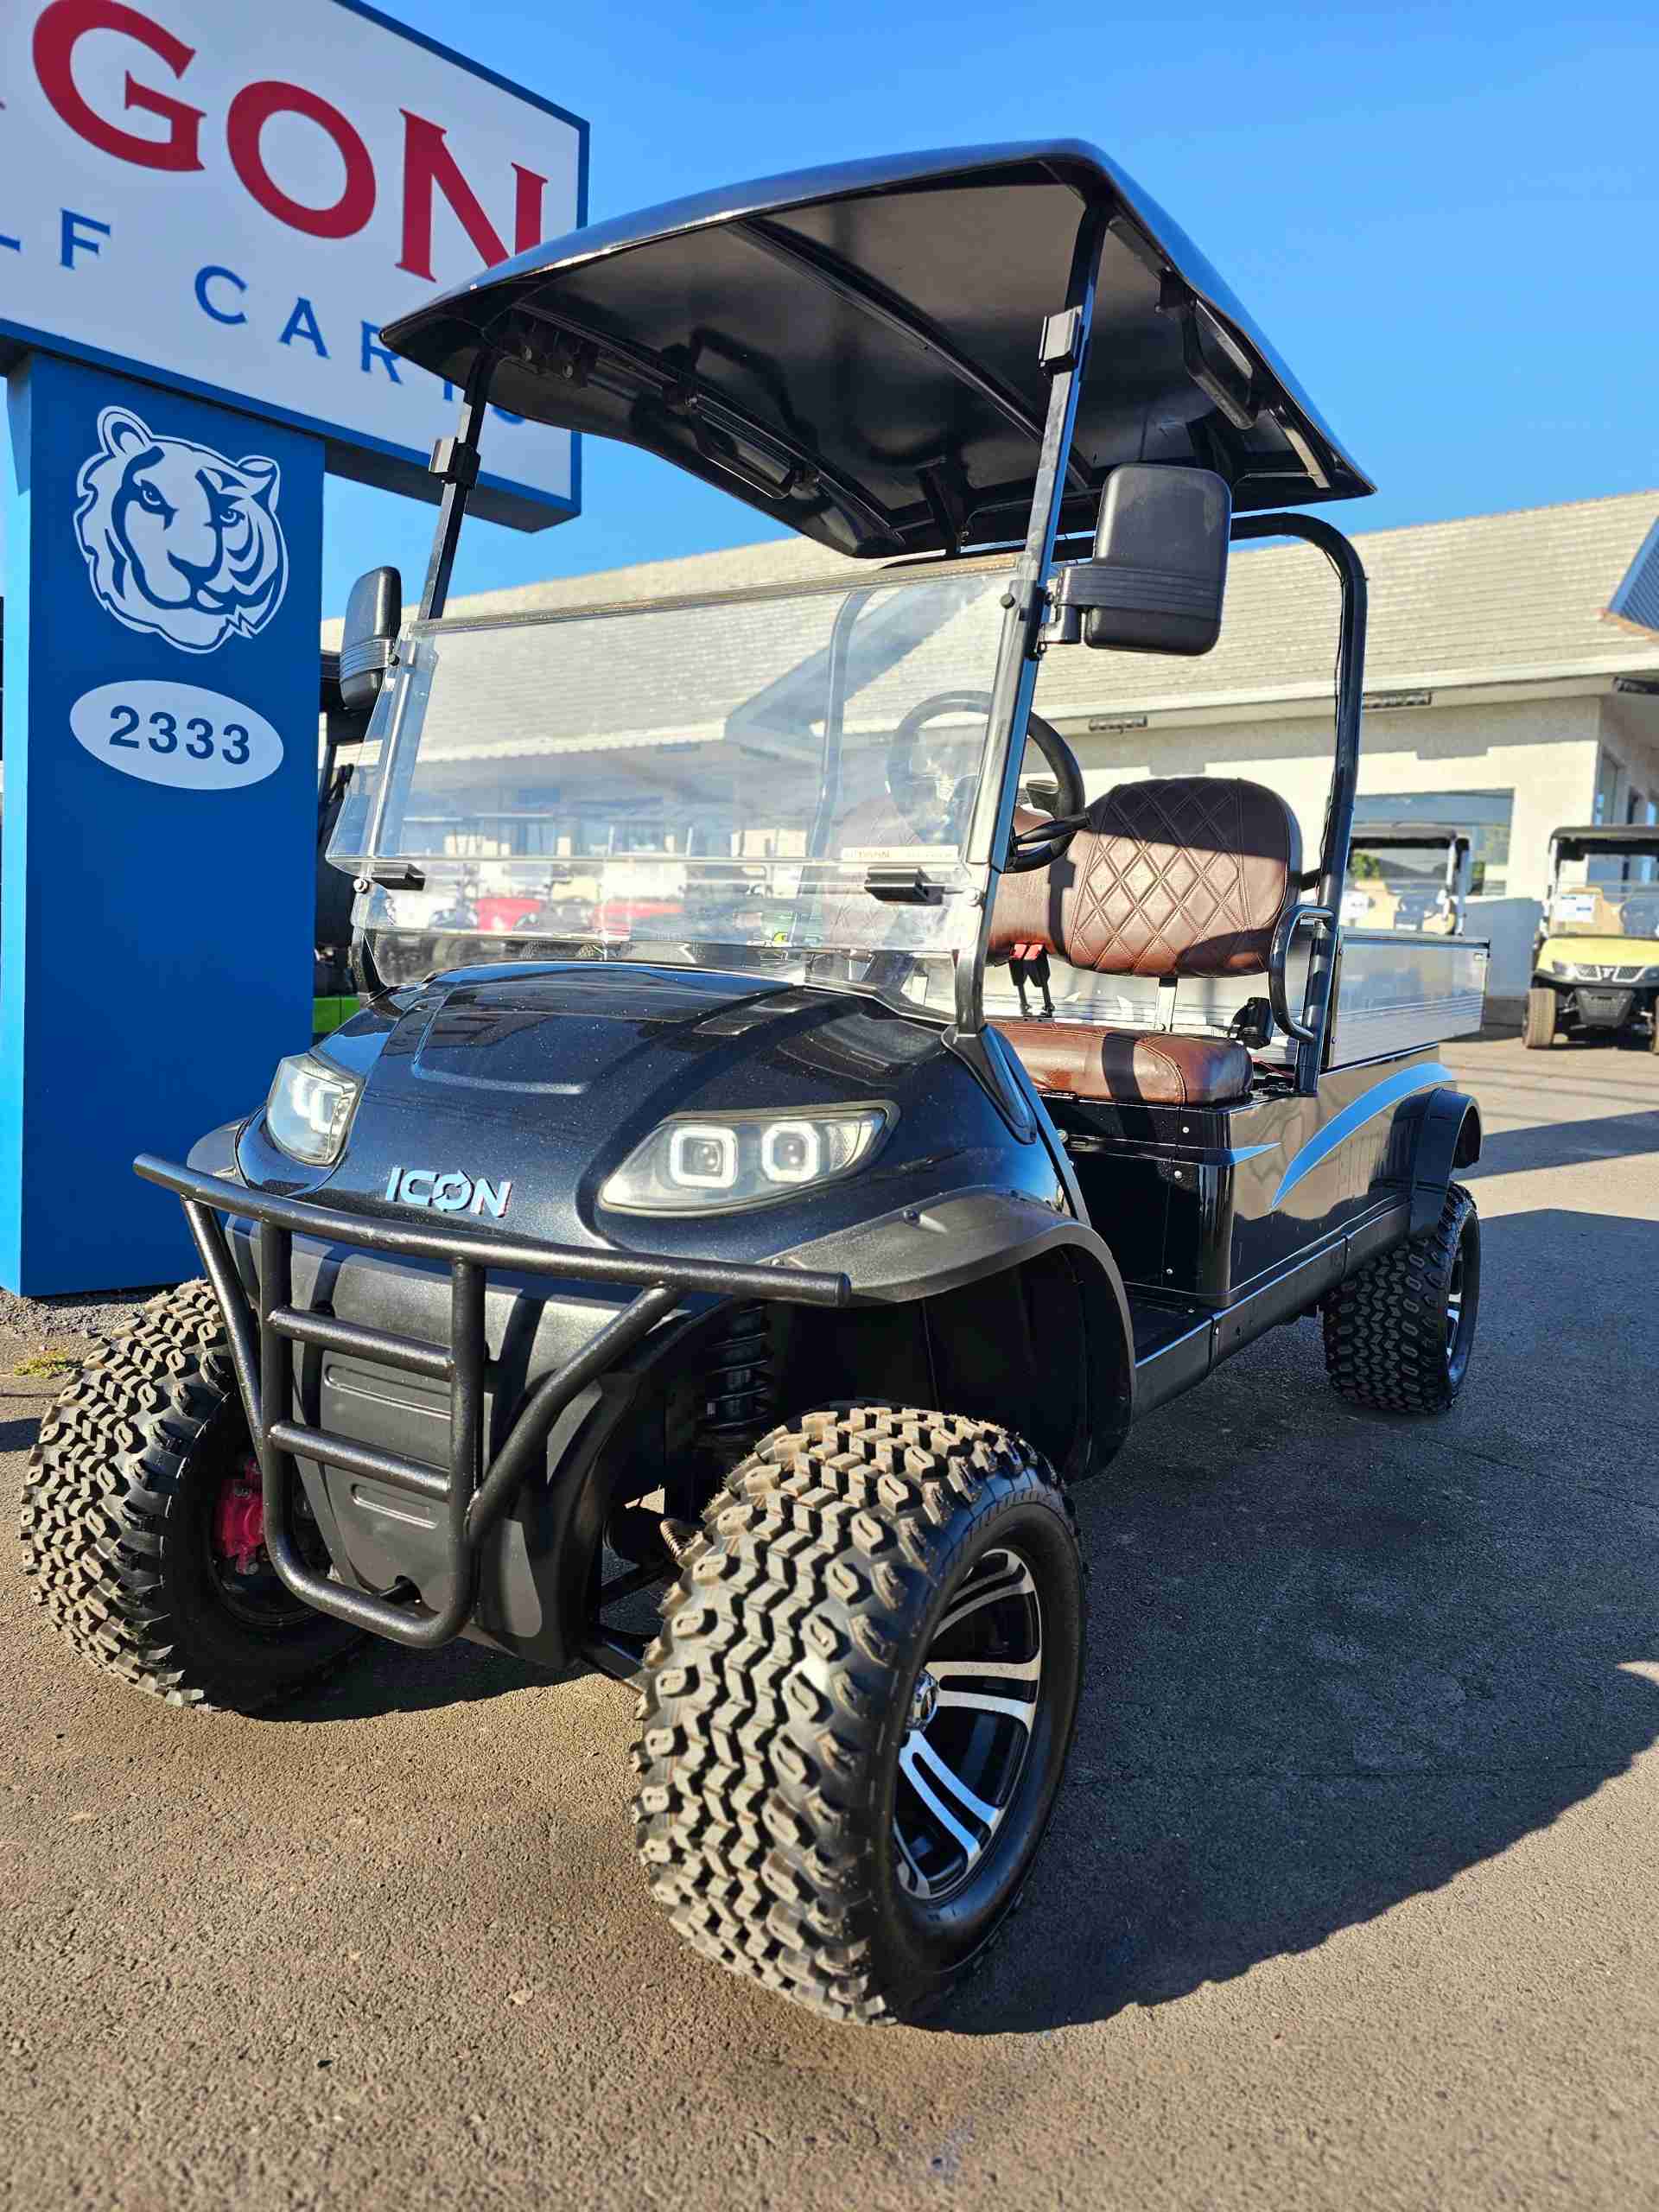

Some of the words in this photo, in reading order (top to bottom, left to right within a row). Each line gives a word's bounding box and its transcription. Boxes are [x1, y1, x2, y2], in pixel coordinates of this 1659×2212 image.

[0, 0, 549, 283] GON
[0, 208, 111, 270] F
[194, 264, 525, 424] CAR
[109, 705, 250, 765] 2333
[386, 1166, 512, 1217] ICON
